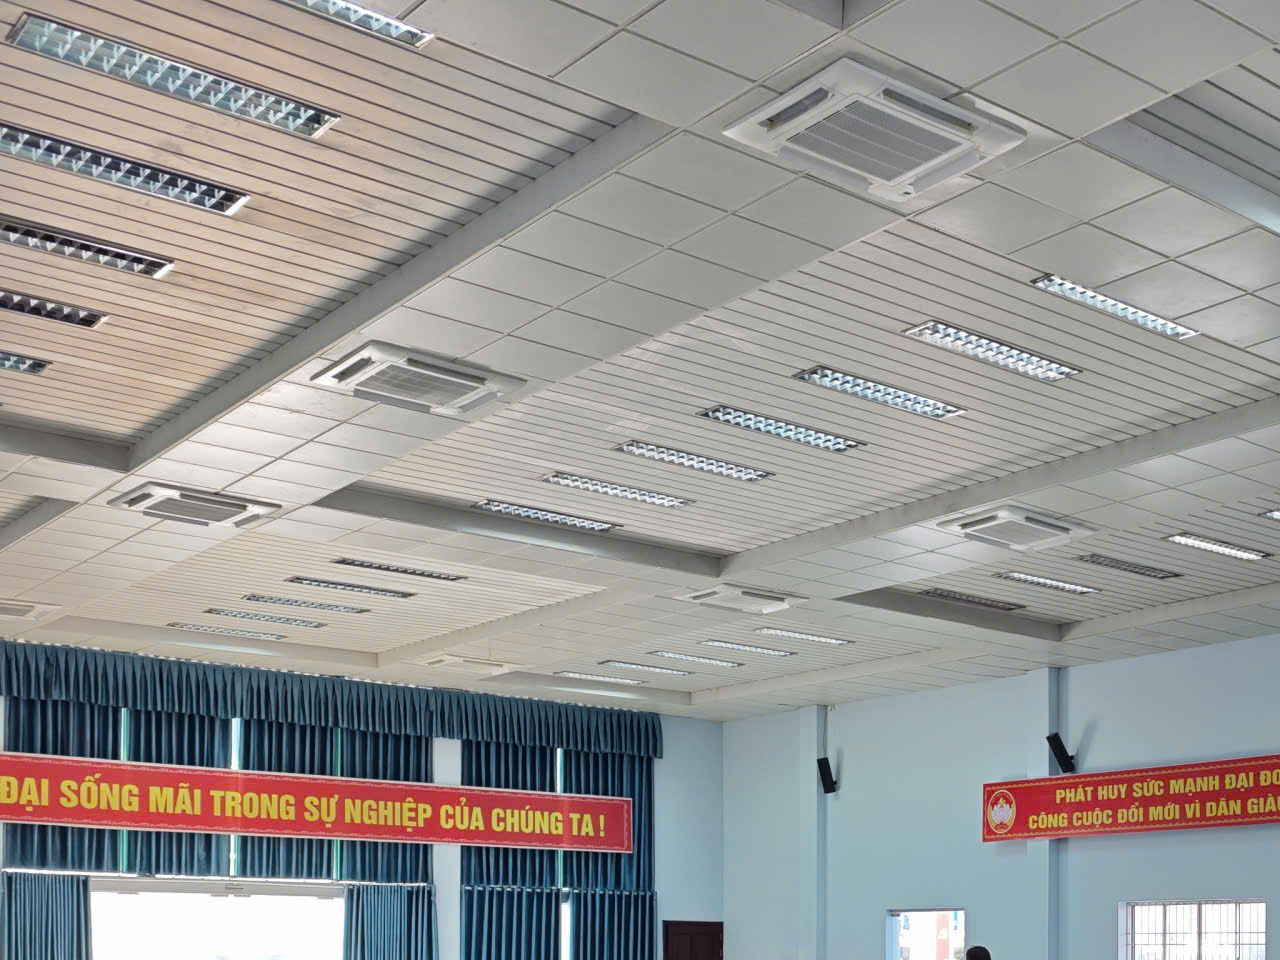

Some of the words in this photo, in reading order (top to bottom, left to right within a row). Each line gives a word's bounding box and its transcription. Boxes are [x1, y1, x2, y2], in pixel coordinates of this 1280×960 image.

[0, 775, 49, 812] ĐẠI
[59, 772, 139, 812] SỐNG
[148, 782, 201, 815] MÃI
[210, 789, 296, 821] TRONG
[303, 794, 340, 828] SỰ
[344, 796, 432, 833] NGHIỆP
[440, 797, 485, 831] CỦA
[491, 805, 564, 835] CHÚNG
[1056, 785, 1093, 803] PHÁT
[1098, 783, 1127, 800] HUY
[1132, 778, 1164, 797] SỨC
[1170, 776, 1219, 796] MẠNH
[1225, 772, 1254, 792] ĐẠI
[1028, 812, 1068, 829] CÔNG
[1072, 809, 1112, 828] CUỘC
[1117, 801, 1144, 824] ĐỔI
[1149, 801, 1180, 821] MỚI
[1184, 799, 1200, 818] VÌ
[1206, 797, 1241, 817] DÂN
